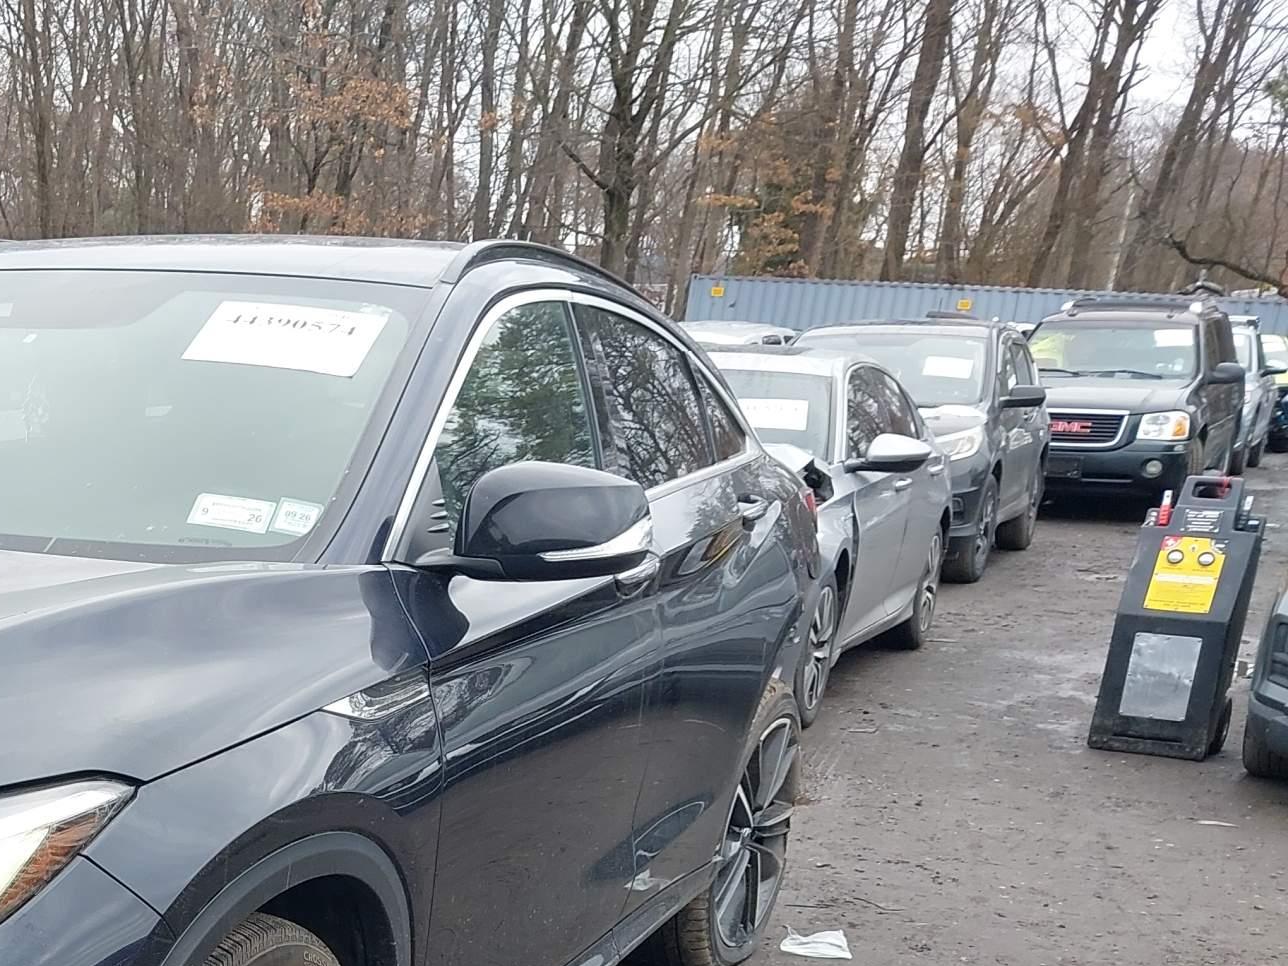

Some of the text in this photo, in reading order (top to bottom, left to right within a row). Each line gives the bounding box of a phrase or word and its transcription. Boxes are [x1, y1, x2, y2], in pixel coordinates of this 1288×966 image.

[226, 314, 357, 336] 44390574
[1048, 421, 1092, 432] GMC
[201, 507, 209, 516] 9
[247, 513, 263, 523] 26
